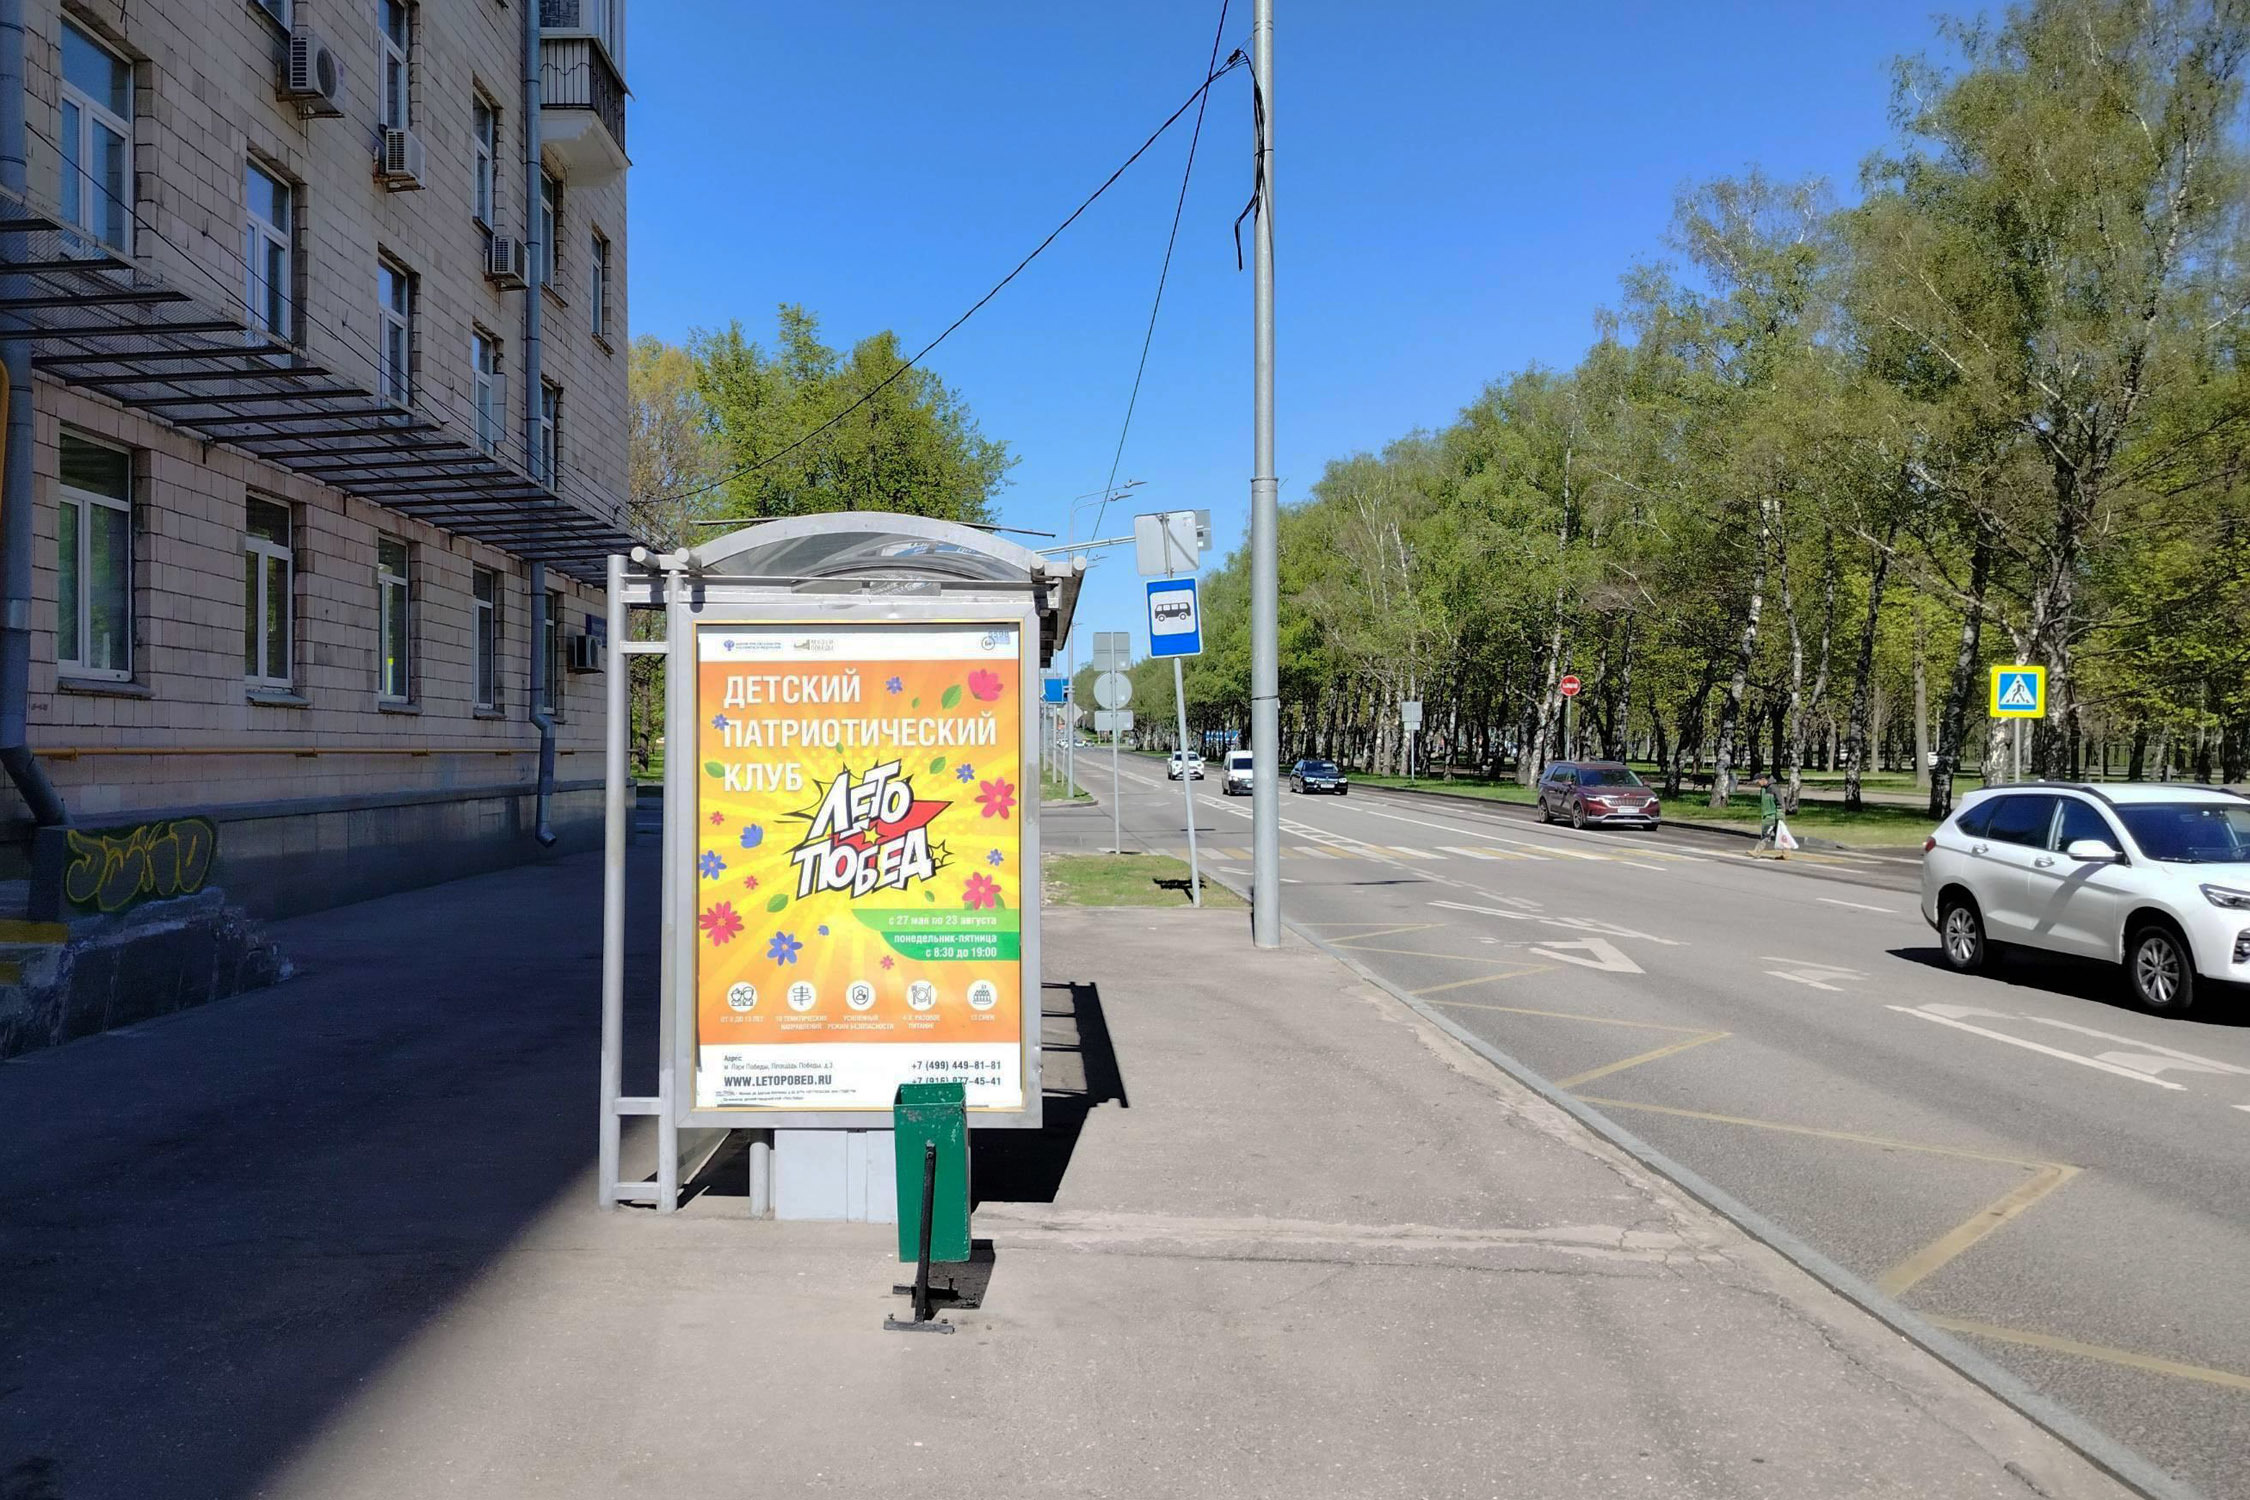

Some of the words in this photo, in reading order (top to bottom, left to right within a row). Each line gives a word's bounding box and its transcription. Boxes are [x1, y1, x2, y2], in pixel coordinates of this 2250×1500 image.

[723, 668, 861, 708] ДЕТСКИЙ
[723, 712, 997, 748] ПАТРИОТИЧЕСКИЙ
[723, 763, 803, 793] КЛУБ
[804, 759, 914, 842] ЛЕТО
[790, 826, 935, 899] ПОБЕД
[888, 917, 894, 925] с
[896, 915, 908, 925] 27
[931, 917, 943, 925] по
[945, 915, 957, 925] 23
[960, 917, 997, 926] августа
[894, 935, 998, 944] понедельник-пятница
[925, 949, 931, 957] с
[933, 947, 954, 957] 8:30
[956, 949, 968, 959] до
[972, 947, 997, 957] 19:00
[911, 1061, 922, 1070] +7
[925, 1060, 949, 1071] (499)
[952, 1060, 1001, 1070] 449-81-81
[724, 1074, 832, 1087] WWW.LETOPOBED.RU
